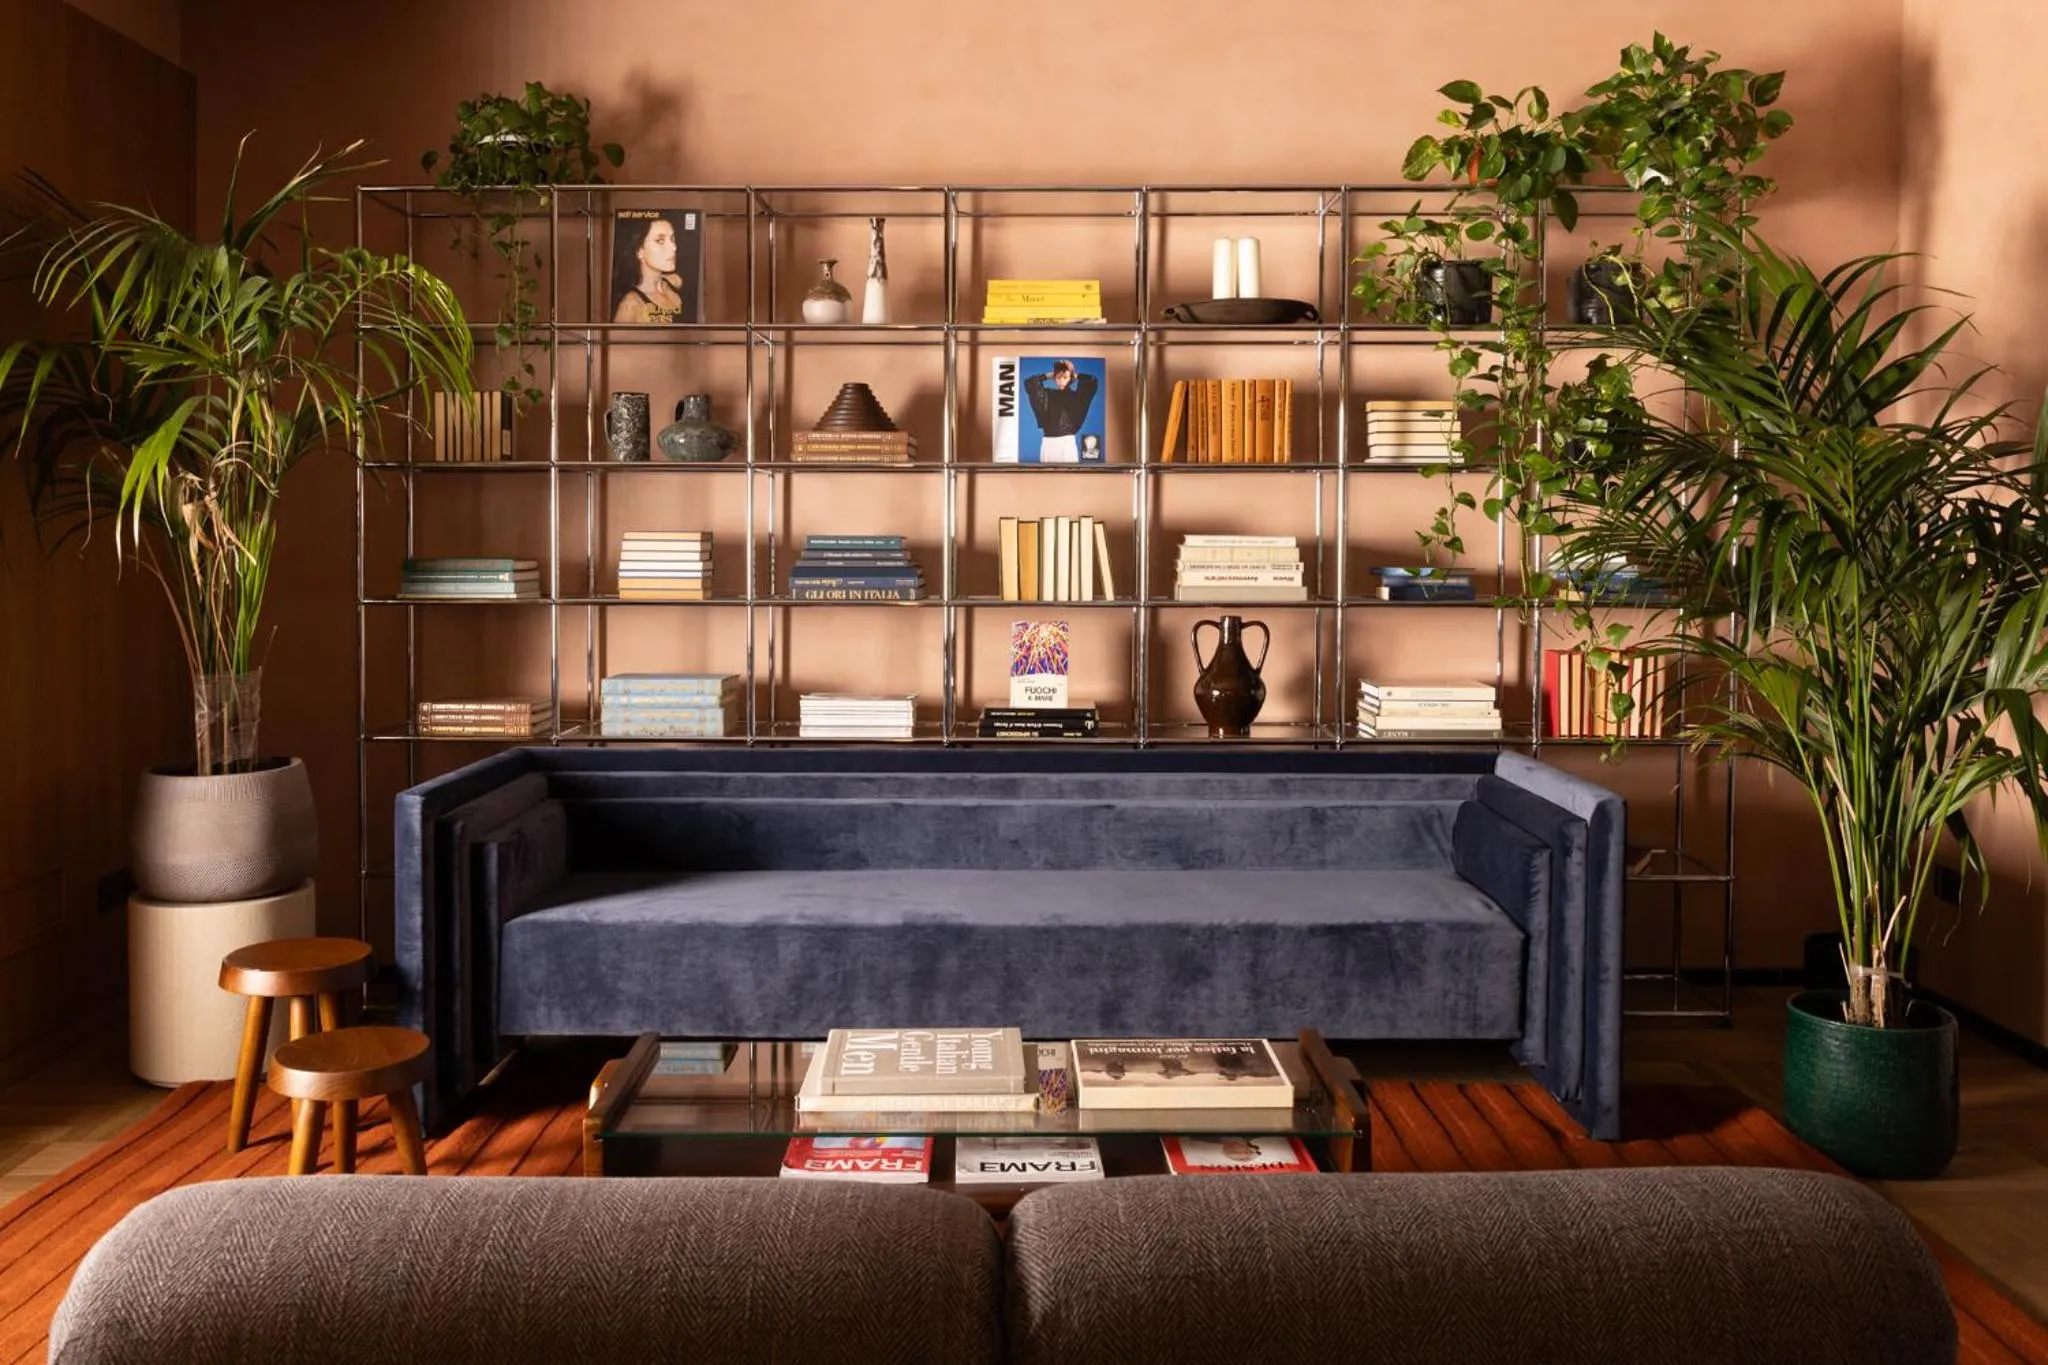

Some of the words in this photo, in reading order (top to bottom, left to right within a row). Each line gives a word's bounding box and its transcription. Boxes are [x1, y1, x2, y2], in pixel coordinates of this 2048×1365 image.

[999, 364, 1015, 417] MAN
[827, 590, 846, 600] ORI
[849, 590, 862, 600] IN
[865, 590, 900, 600] ITALIA
[1025, 686, 1057, 695] FUOCHI
[841, 1031, 898, 1076] Men
[936, 1033, 969, 1073] Italian
[963, 1031, 1002, 1070] Young
